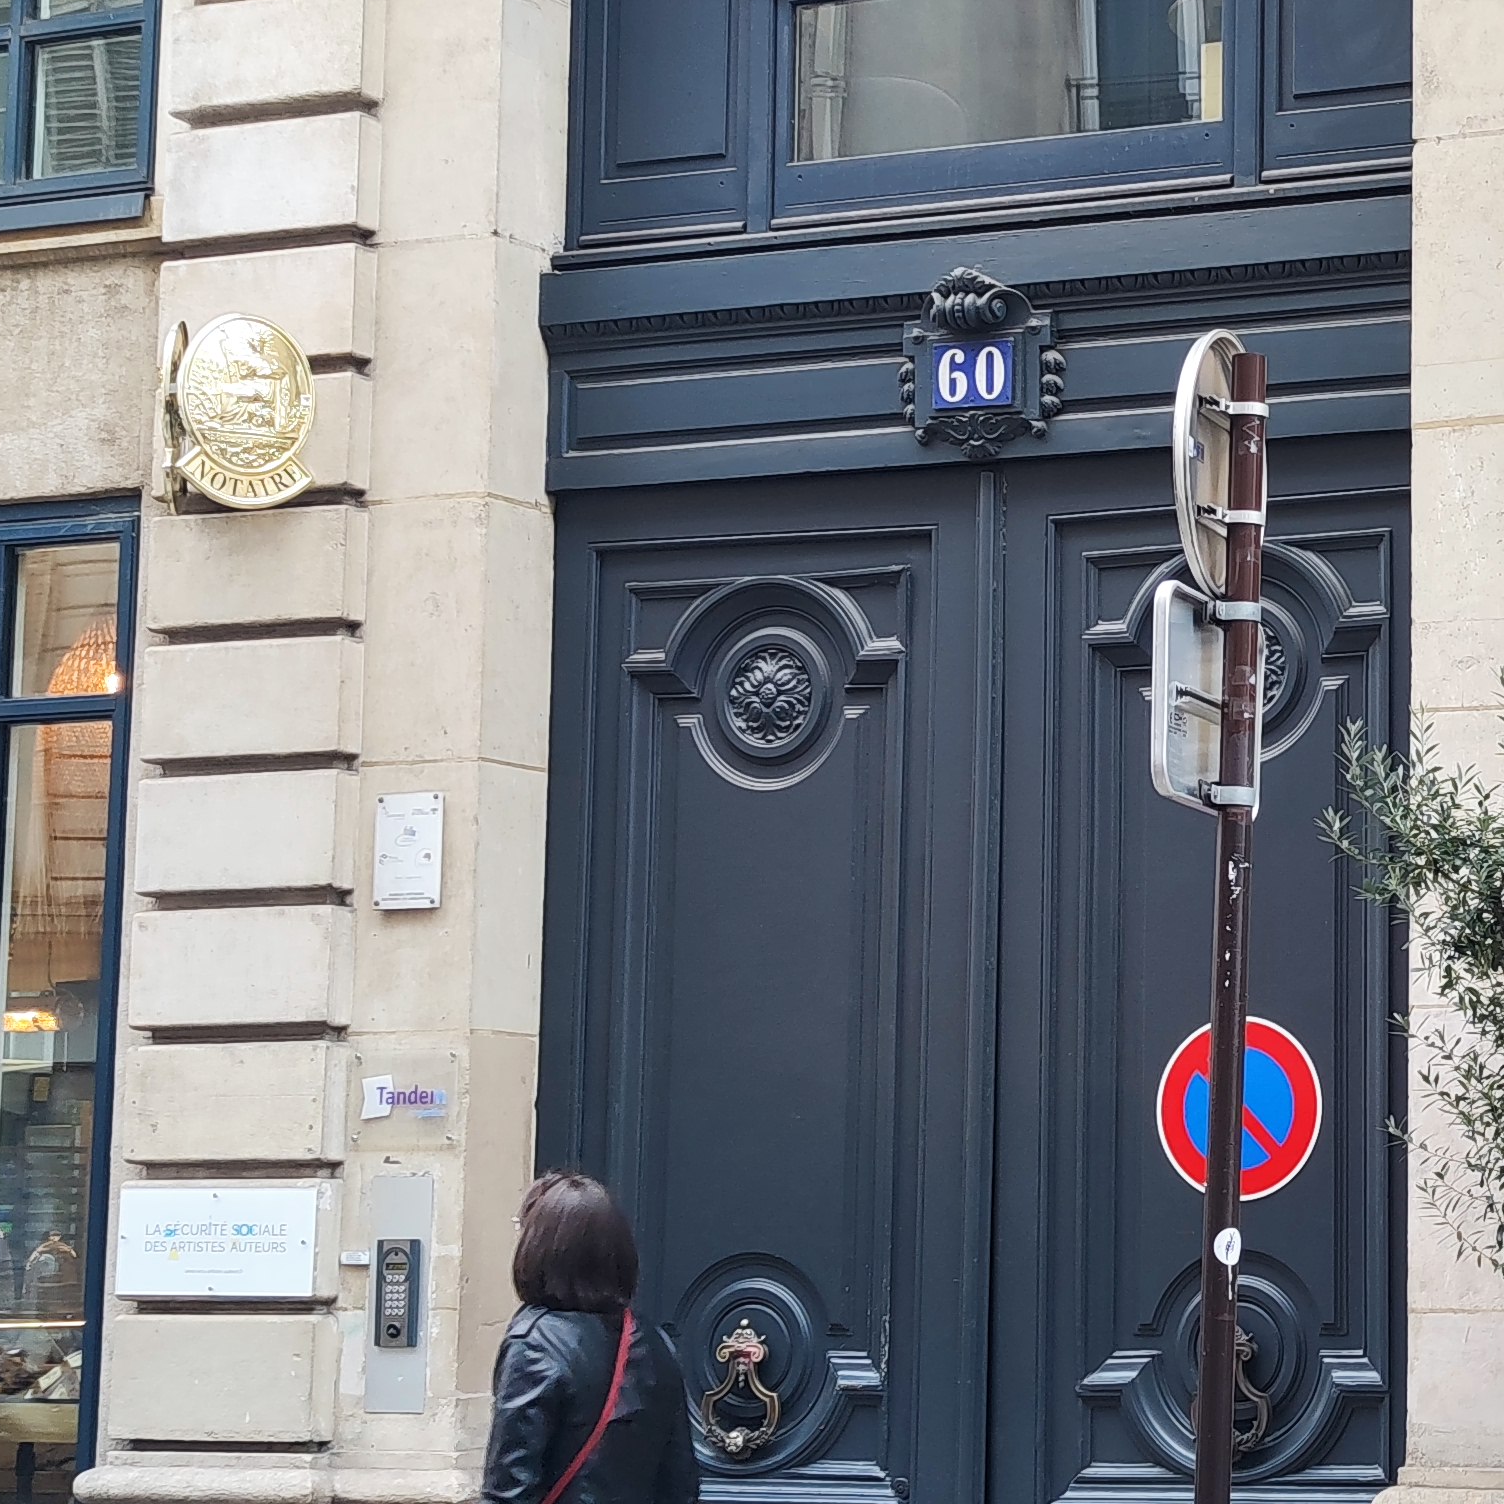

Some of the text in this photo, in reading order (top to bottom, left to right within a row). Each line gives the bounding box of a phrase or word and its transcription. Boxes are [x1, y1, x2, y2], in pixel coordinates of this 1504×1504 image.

[938, 346, 1005, 403] 60
[191, 459, 303, 497] NOTAIRE
[145, 1217, 287, 1237] LA SÉCURITÉ SOCIALE
[145, 1241, 286, 1253] DES ARTISTES AUTEURS
